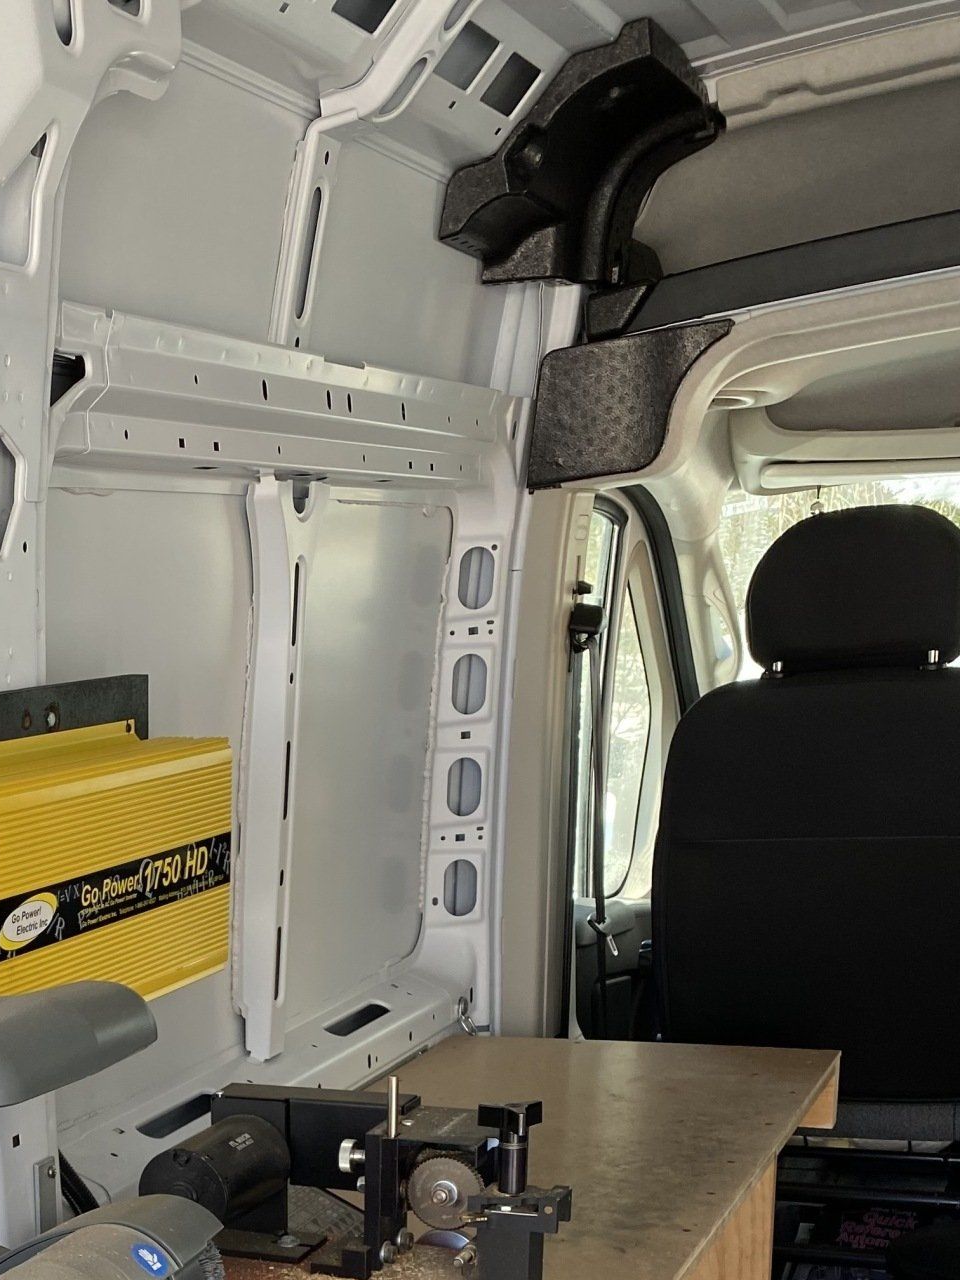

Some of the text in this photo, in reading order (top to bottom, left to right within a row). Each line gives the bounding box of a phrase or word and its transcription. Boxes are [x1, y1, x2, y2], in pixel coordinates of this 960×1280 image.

[81, 884, 99, 907] Go
[145, 854, 182, 894] 1750
[184, 846, 208, 880] HD
[11, 906, 42, 924] Go Power!
[16, 918, 49, 936] Electric Inc
